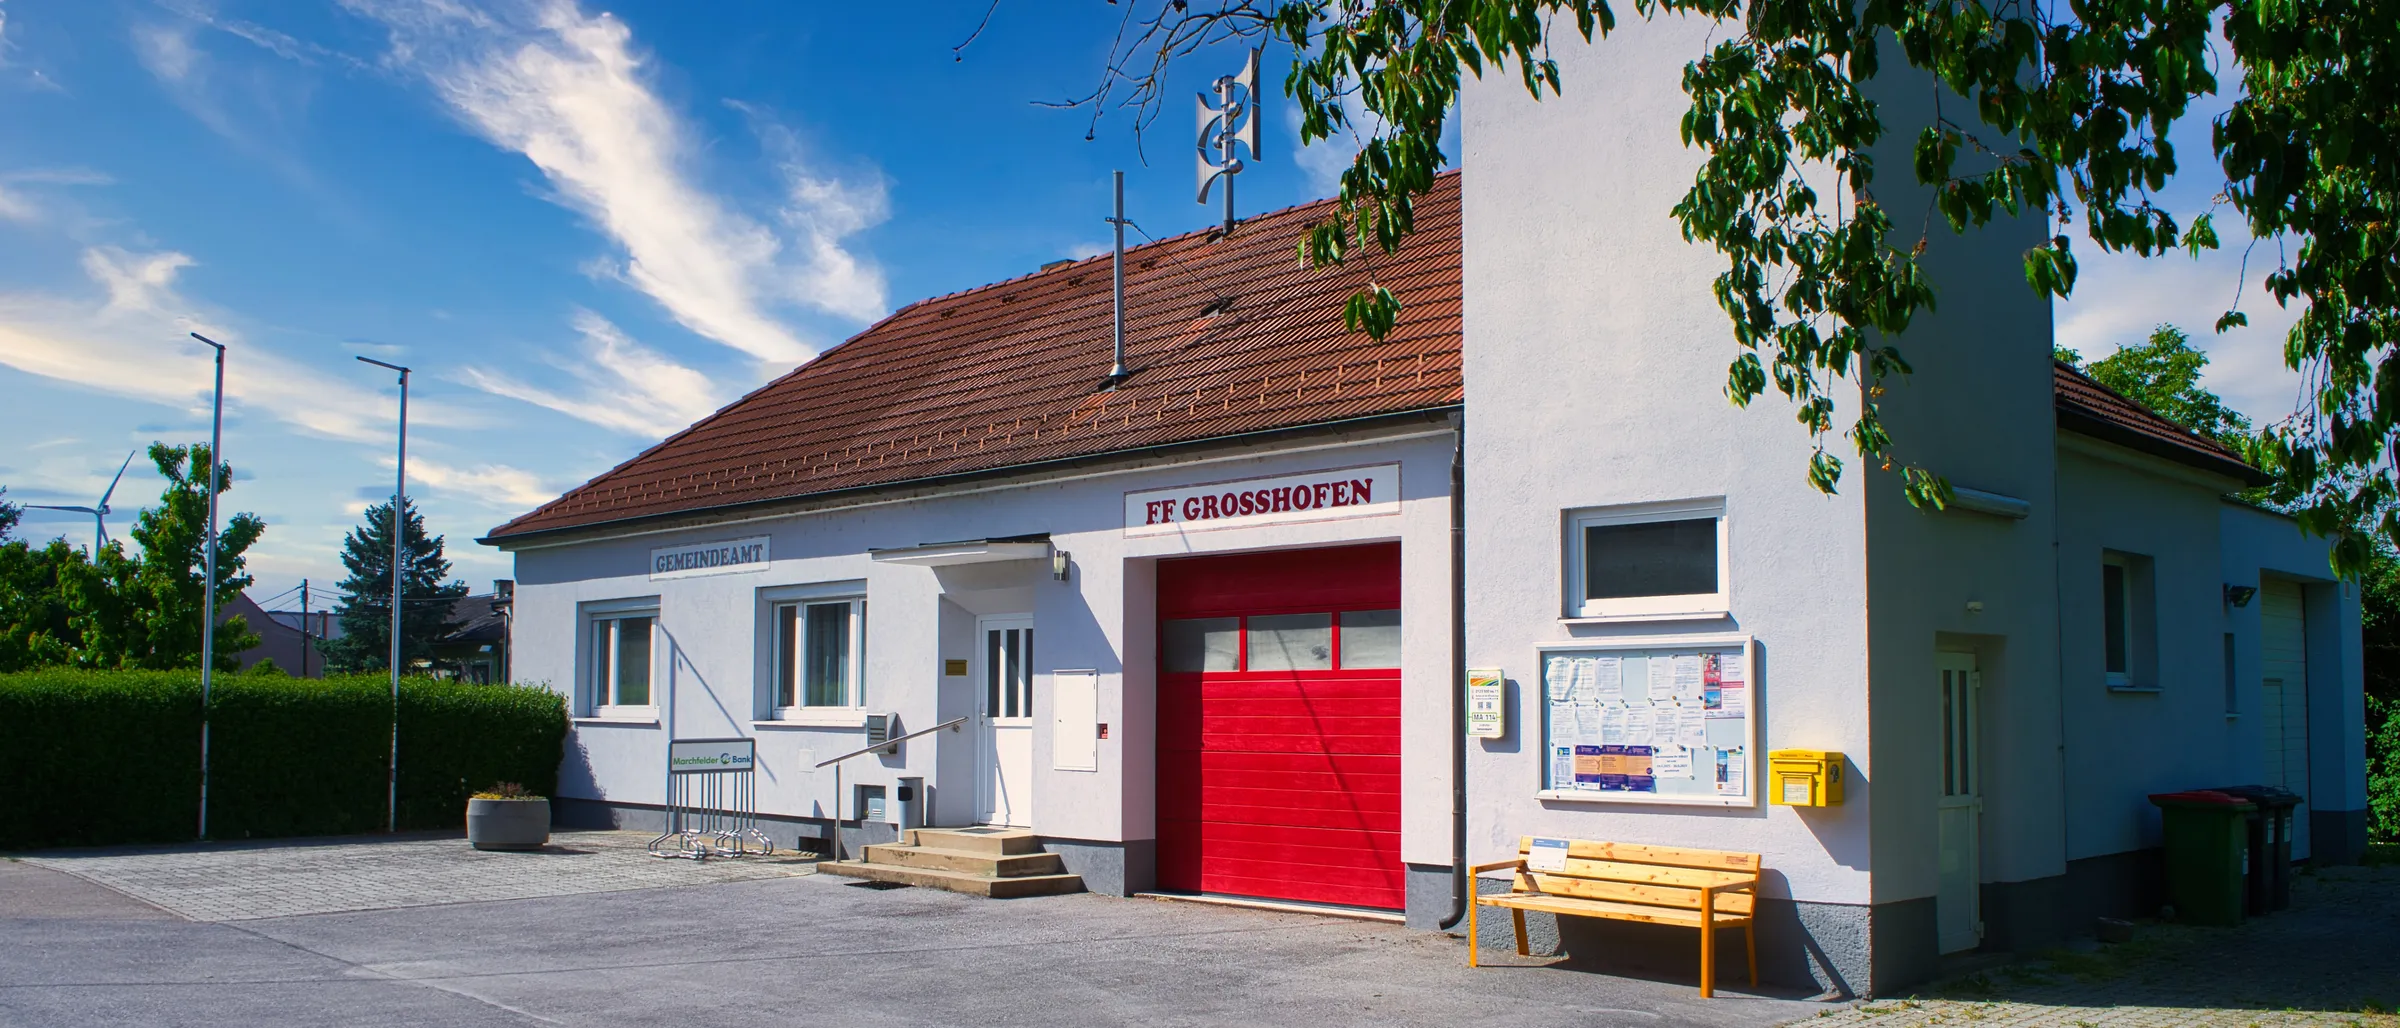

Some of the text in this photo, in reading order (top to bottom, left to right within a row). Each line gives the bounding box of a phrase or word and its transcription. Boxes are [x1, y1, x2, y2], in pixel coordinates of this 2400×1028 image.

[1182, 478, 1373, 521] GROSSHOFEN
[656, 544, 763, 573] GEMEINDEAMT
[673, 755, 752, 765] Marchfelder Bank
